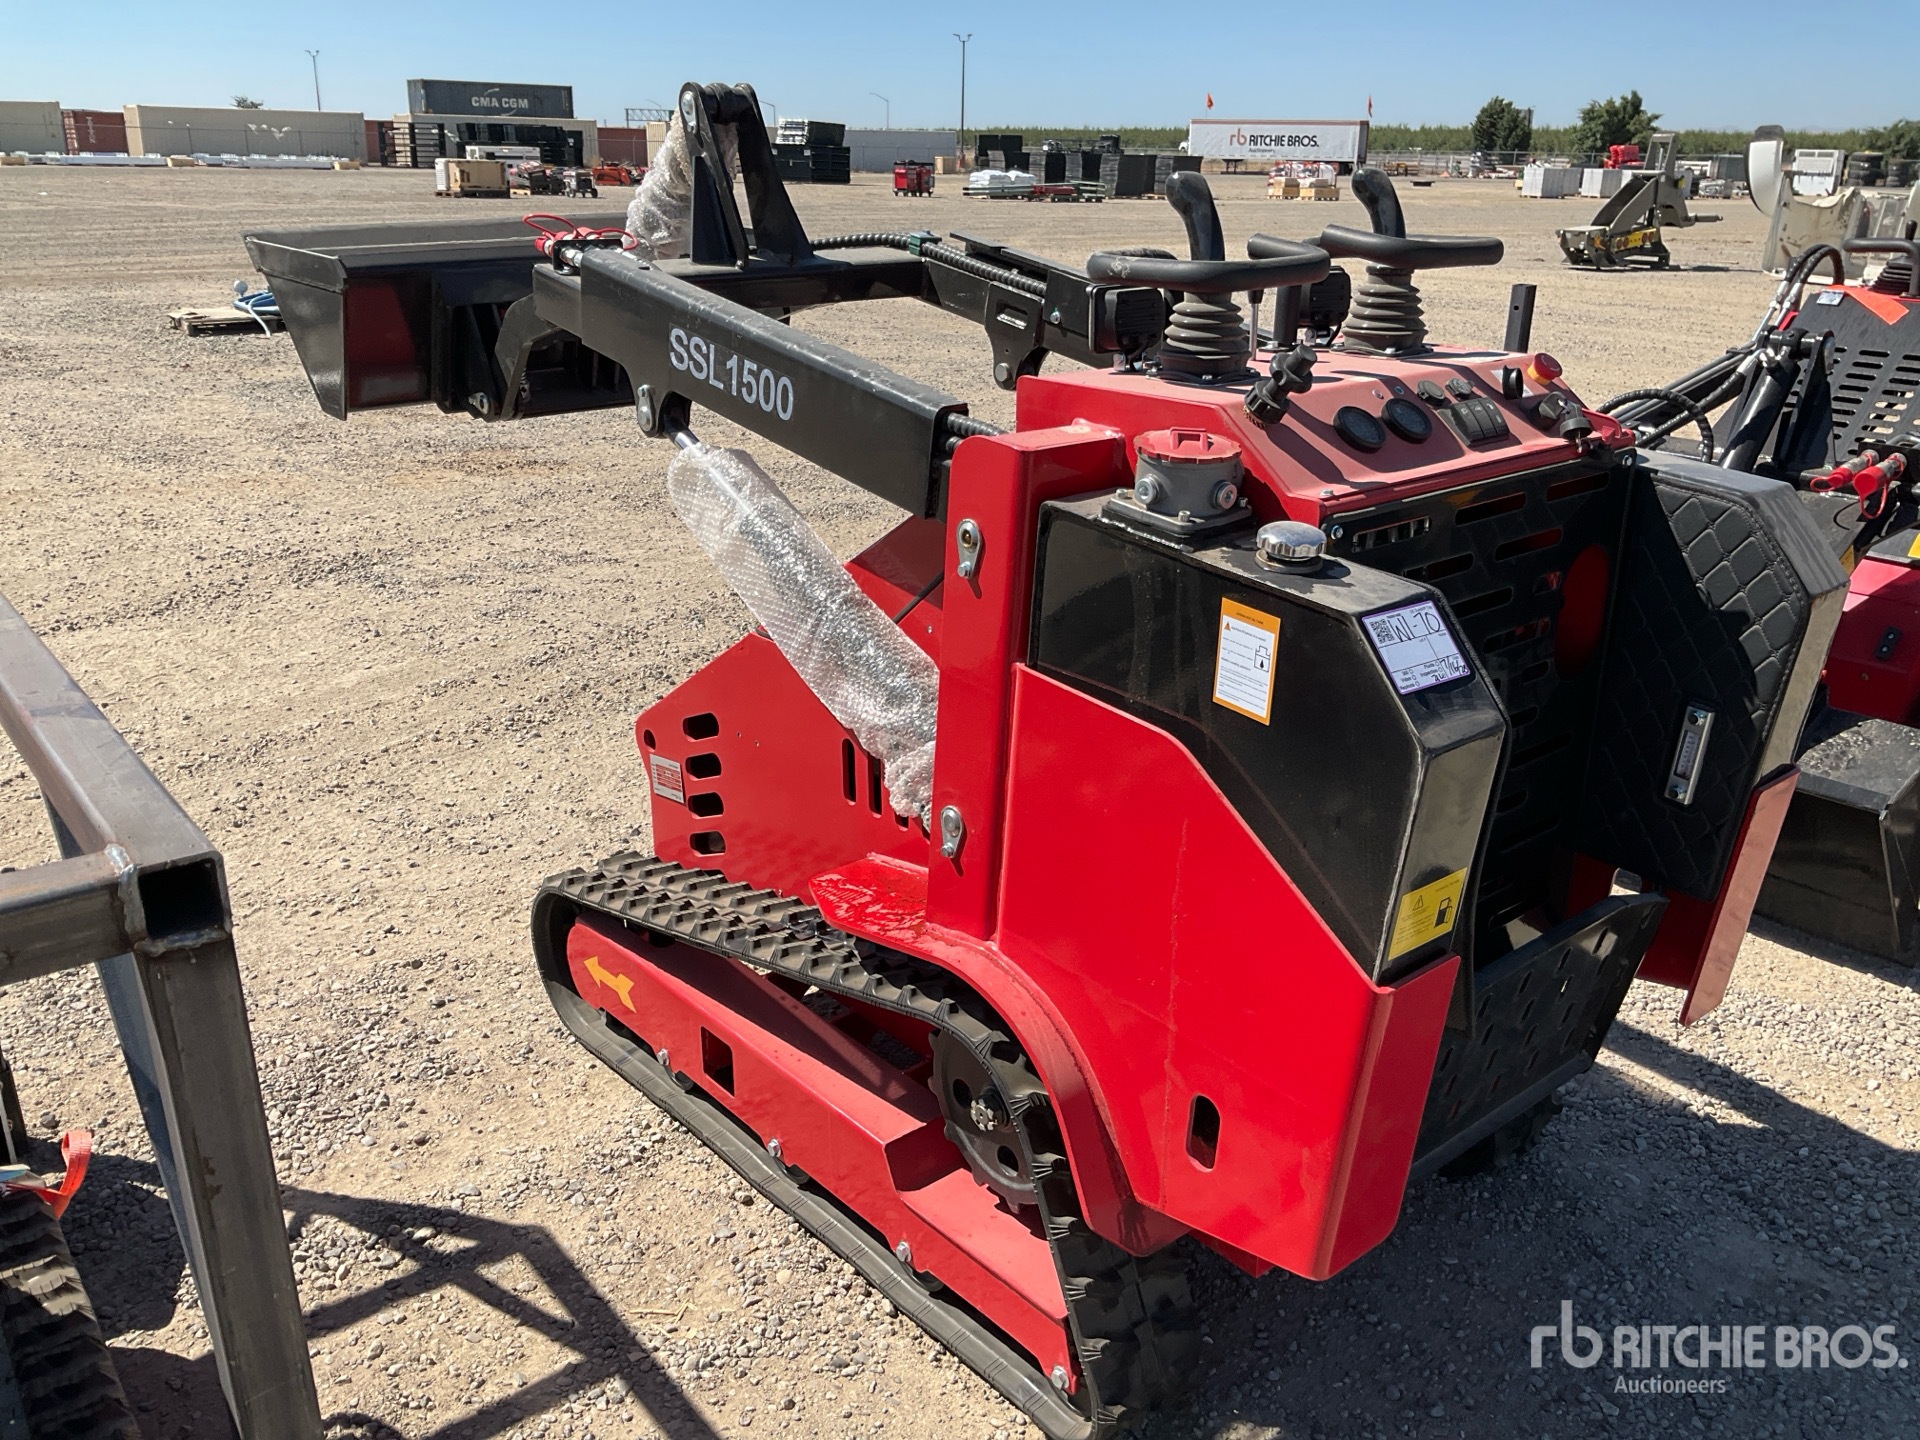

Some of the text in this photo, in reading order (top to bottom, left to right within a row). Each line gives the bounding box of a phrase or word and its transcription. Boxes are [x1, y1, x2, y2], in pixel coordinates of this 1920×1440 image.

[471, 96, 528, 109] CMA CGM
[1229, 128, 1319, 147] rb RITCHIE BROS.
[669, 328, 794, 421] SSL1500
